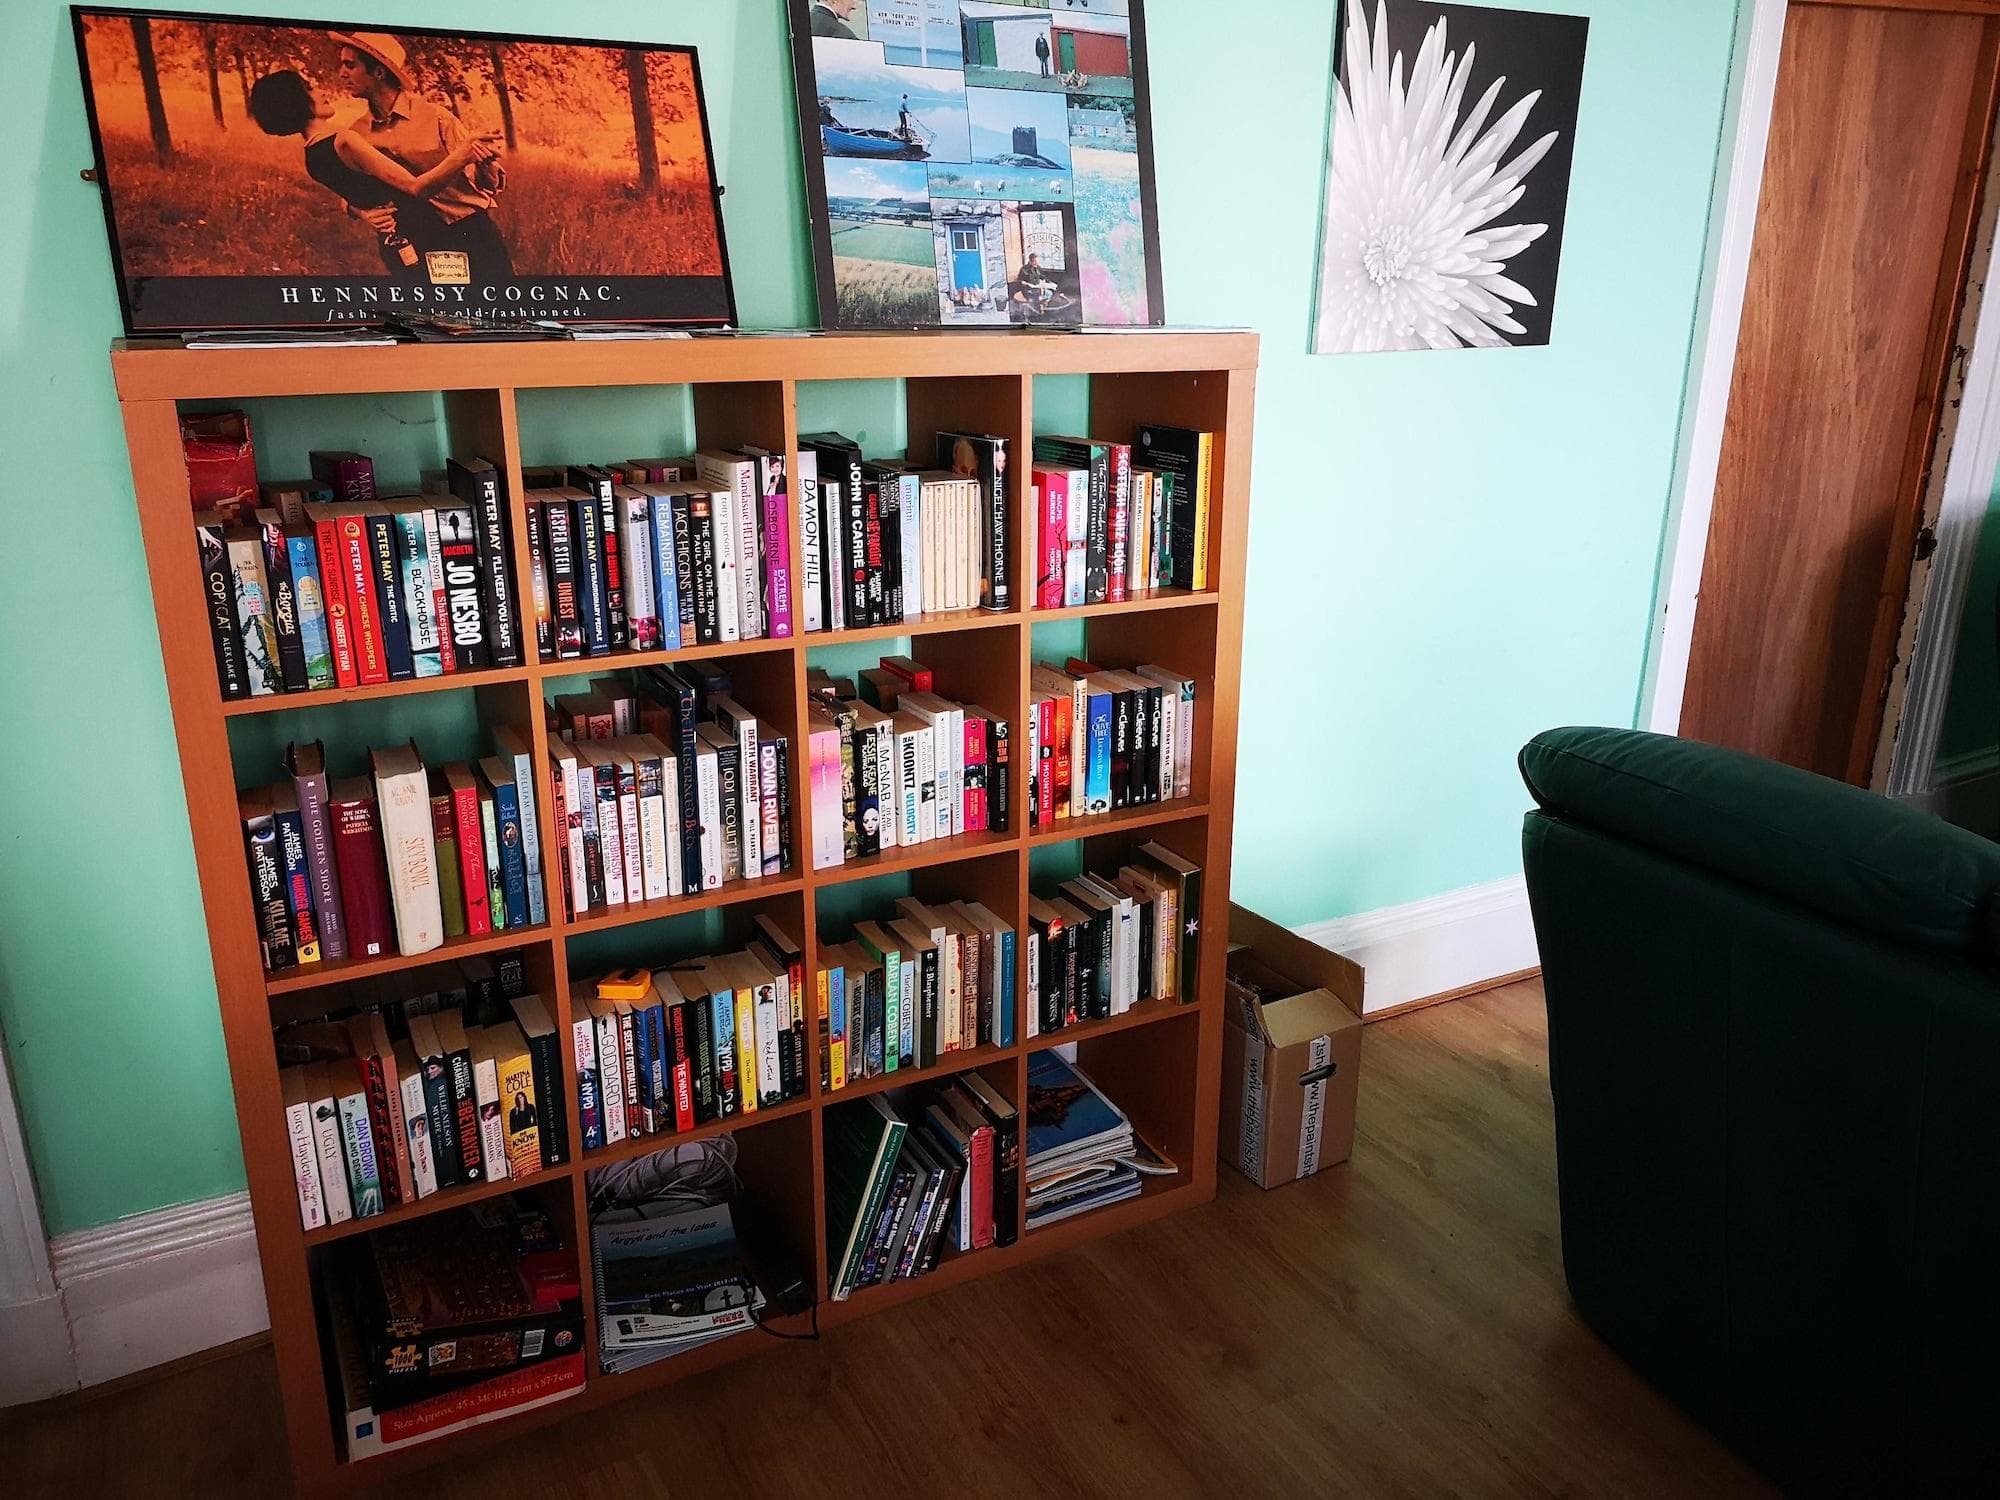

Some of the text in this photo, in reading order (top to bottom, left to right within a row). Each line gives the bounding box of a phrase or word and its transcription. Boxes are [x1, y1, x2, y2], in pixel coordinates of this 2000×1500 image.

[281, 286, 621, 302] HENNESSY COGNAC.
[484, 481, 501, 550] PETER MAY
[529, 517, 539, 546] TWIST
[584, 505, 597, 561] PETER MAY
[701, 520, 709, 539] THE
[740, 469, 754, 561] Mandasue HELLER
[768, 500, 780, 566] OSBOURNE
[804, 479, 820, 589] DAMON HILL
[850, 462, 865, 568] JOHN le CARRÉ
[994, 477, 1004, 581] NIGEL HAWTHORNE
[1113, 452, 1128, 574] SCOTTISH QUIZ BOOK
[376, 524, 394, 583] PETER MAY
[532, 549, 540, 560] OF
[550, 507, 571, 574] JESPER STEIN
[658, 502, 672, 576] REMAINDER
[672, 507, 692, 590] JACK HIGGINS
[703, 540, 711, 561] GIRL
[320, 530, 331, 544] THE
[326, 567, 339, 602] SUNRISE
[349, 540, 365, 595] PETER MAY
[534, 563, 543, 578] THE
[694, 534, 705, 614] PAULA HAWKINS
[704, 564, 712, 578] ON
[705, 580, 713, 598] THE
[777, 568, 787, 613] EXTREME
[209, 572, 231, 631] COPYCAT
[276, 589, 295, 635] Borgias
[386, 584, 399, 624] THE CRITIC
[411, 567, 431, 644] BLACKHOUSE
[446, 561, 482, 646] JO NESBO
[492, 556, 511, 648] I'LL KEEP YOU SAFE
[536, 580, 544, 612] KNIFE
[557, 582, 575, 620] UNREST
[706, 600, 715, 626] TRAIN
[744, 567, 754, 619] The Club
[334, 619, 352, 671] ROBERT RYAN
[357, 596, 376, 670] CHINESE WHISPERS
[437, 596, 450, 649] Shakespeare
[221, 637, 237, 680] ALEX LAKE
[681, 697, 693, 723] The
[1118, 714, 1128, 752] Cleeves
[1135, 711, 1146, 750] Cleeves
[1152, 709, 1161, 748] Cleeves
[520, 768, 530, 808] WILLIAM
[749, 759, 758, 802] WARRANT
[866, 732, 878, 797] JESSIE KEANE
[879, 749, 891, 802] McNAB
[904, 742, 915, 791] KOONTZ
[1058, 760, 1068, 786] DRY
[460, 795, 468, 829] BENIOFF
[467, 798, 476, 826] DAVID
[723, 767, 737, 846] JODI PICOULT
[762, 745, 779, 846] DOWN RIVER
[906, 792, 916, 834] VELOCITY
[282, 822, 303, 871] JAMES PATTERSON
[308, 794, 332, 903] THE GOLDEN SHORE
[345, 821, 368, 829] PATRICIA
[524, 812, 535, 847] TREVOR
[607, 804, 622, 880] PETER ROBINSON
[627, 800, 640, 878] PETER ROBINSON
[255, 845, 278, 902] JAMES PATTERSON
[405, 836, 430, 890] SKYBOWL
[292, 874, 313, 941] MURDER GAMES
[718, 997, 729, 1042] PATTERSON
[887, 955, 899, 1047] HARLAN COBEN
[902, 974, 912, 1031] Harlan COBEN
[923, 973, 934, 1018] Blasphemer
[576, 1026, 591, 1071] JAMES PATTERSON
[673, 1007, 684, 1062] ROBERT CRAIS
[452, 1056, 465, 1100] CHAMBERS
[602, 1034, 619, 1105] GODDARD
[622, 1016, 637, 1104] THE SECRET FOOTBALLER'S
[506, 1078, 532, 1094] COLE
[582, 1083, 593, 1110] NYPD
[677, 1062, 689, 1112] THE WANTED
[437, 1084, 454, 1148] WILLIE NELSON
[458, 1108, 481, 1168] BETRAYER
[512, 1134, 536, 1148] KNOW
[586, 1126, 597, 1138] 4
[292, 1107, 311, 1176] Torey Hayden
[322, 1128, 336, 1160] UGLY
[355, 1118, 376, 1180] DAN BROWN
[610, 1221, 719, 1246] Argyll and the Isles
[895, 1206, 905, 1222] Color
[712, 1313, 744, 1325] PRESS
[393, 1419, 415, 1432] Size
